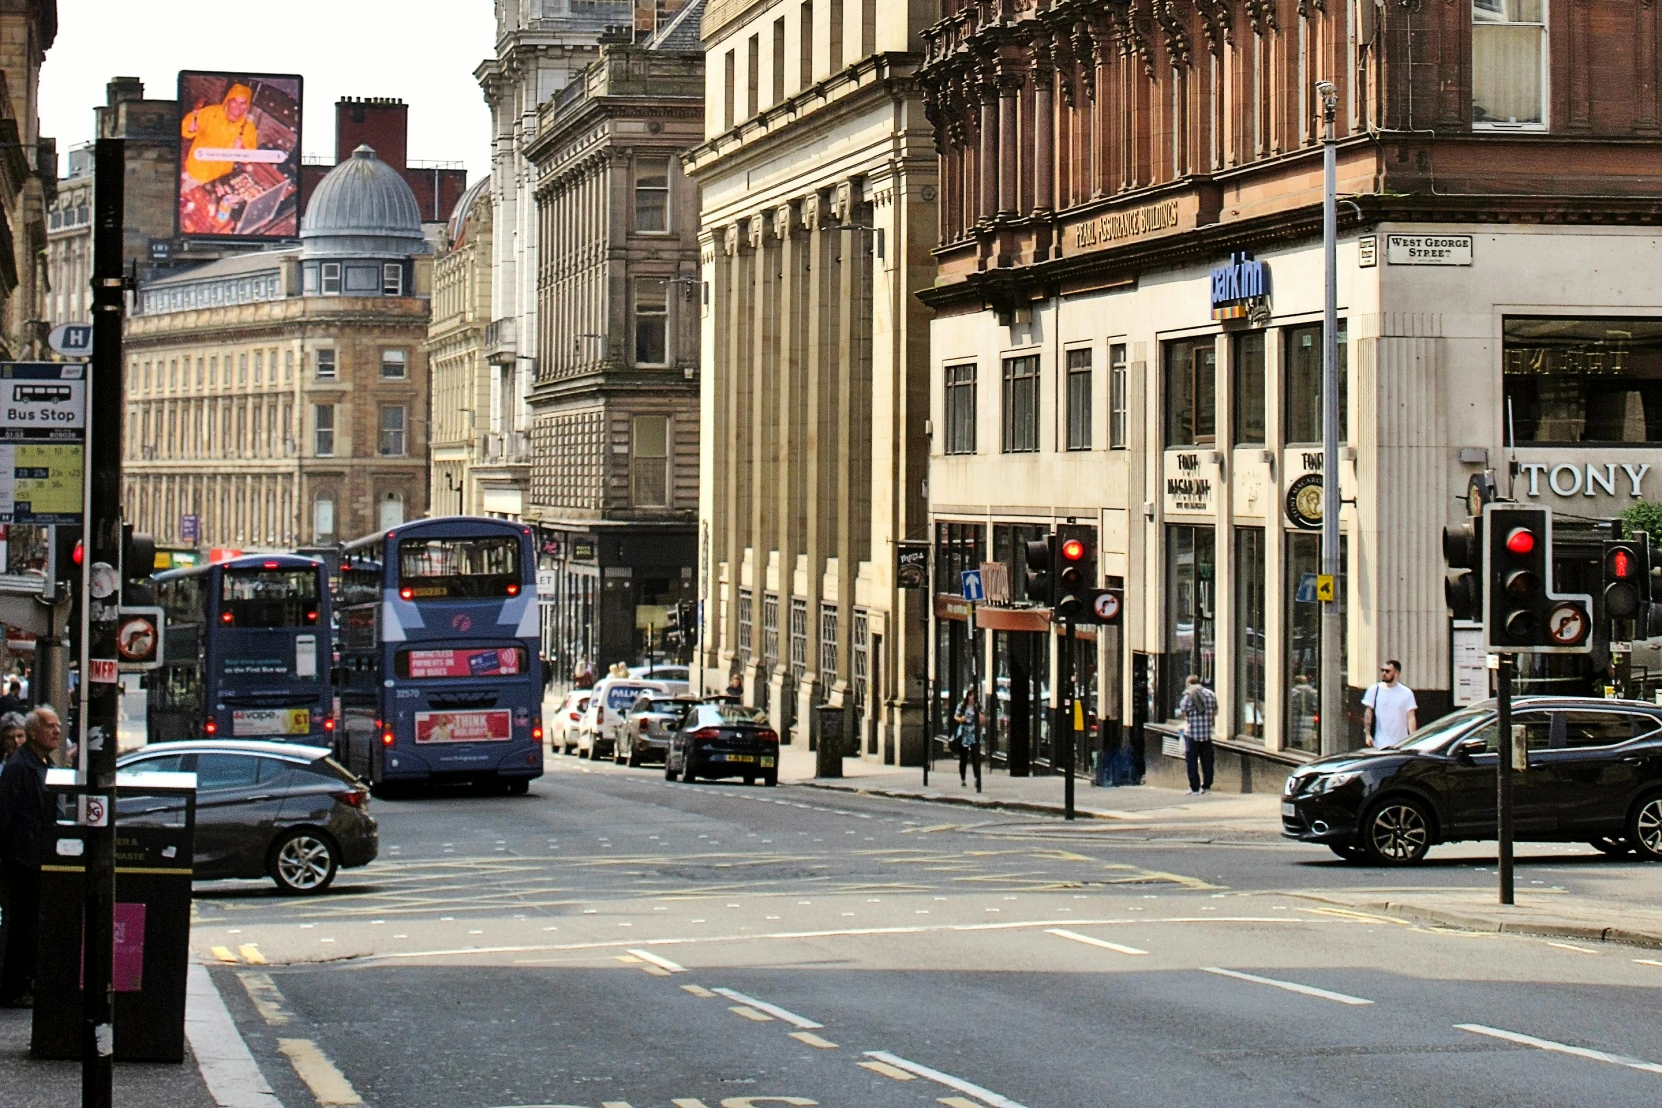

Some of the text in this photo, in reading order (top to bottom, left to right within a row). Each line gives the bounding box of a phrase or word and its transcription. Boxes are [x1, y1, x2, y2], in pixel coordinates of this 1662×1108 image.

[1076, 201, 1178, 248] PEARL ASSURANCE BUILDINGS
[1391, 237, 1469, 248] WEST GEORGE
[1408, 248, 1452, 258] STREET
[1211, 252, 1263, 320] park inn
[70, 329, 83, 345] H
[8, 408, 75, 422] Bus Stop
[1292, 476, 1323, 494] MACARO
[1521, 463, 1651, 496] TONY
[611, 688, 639, 698] PALM
